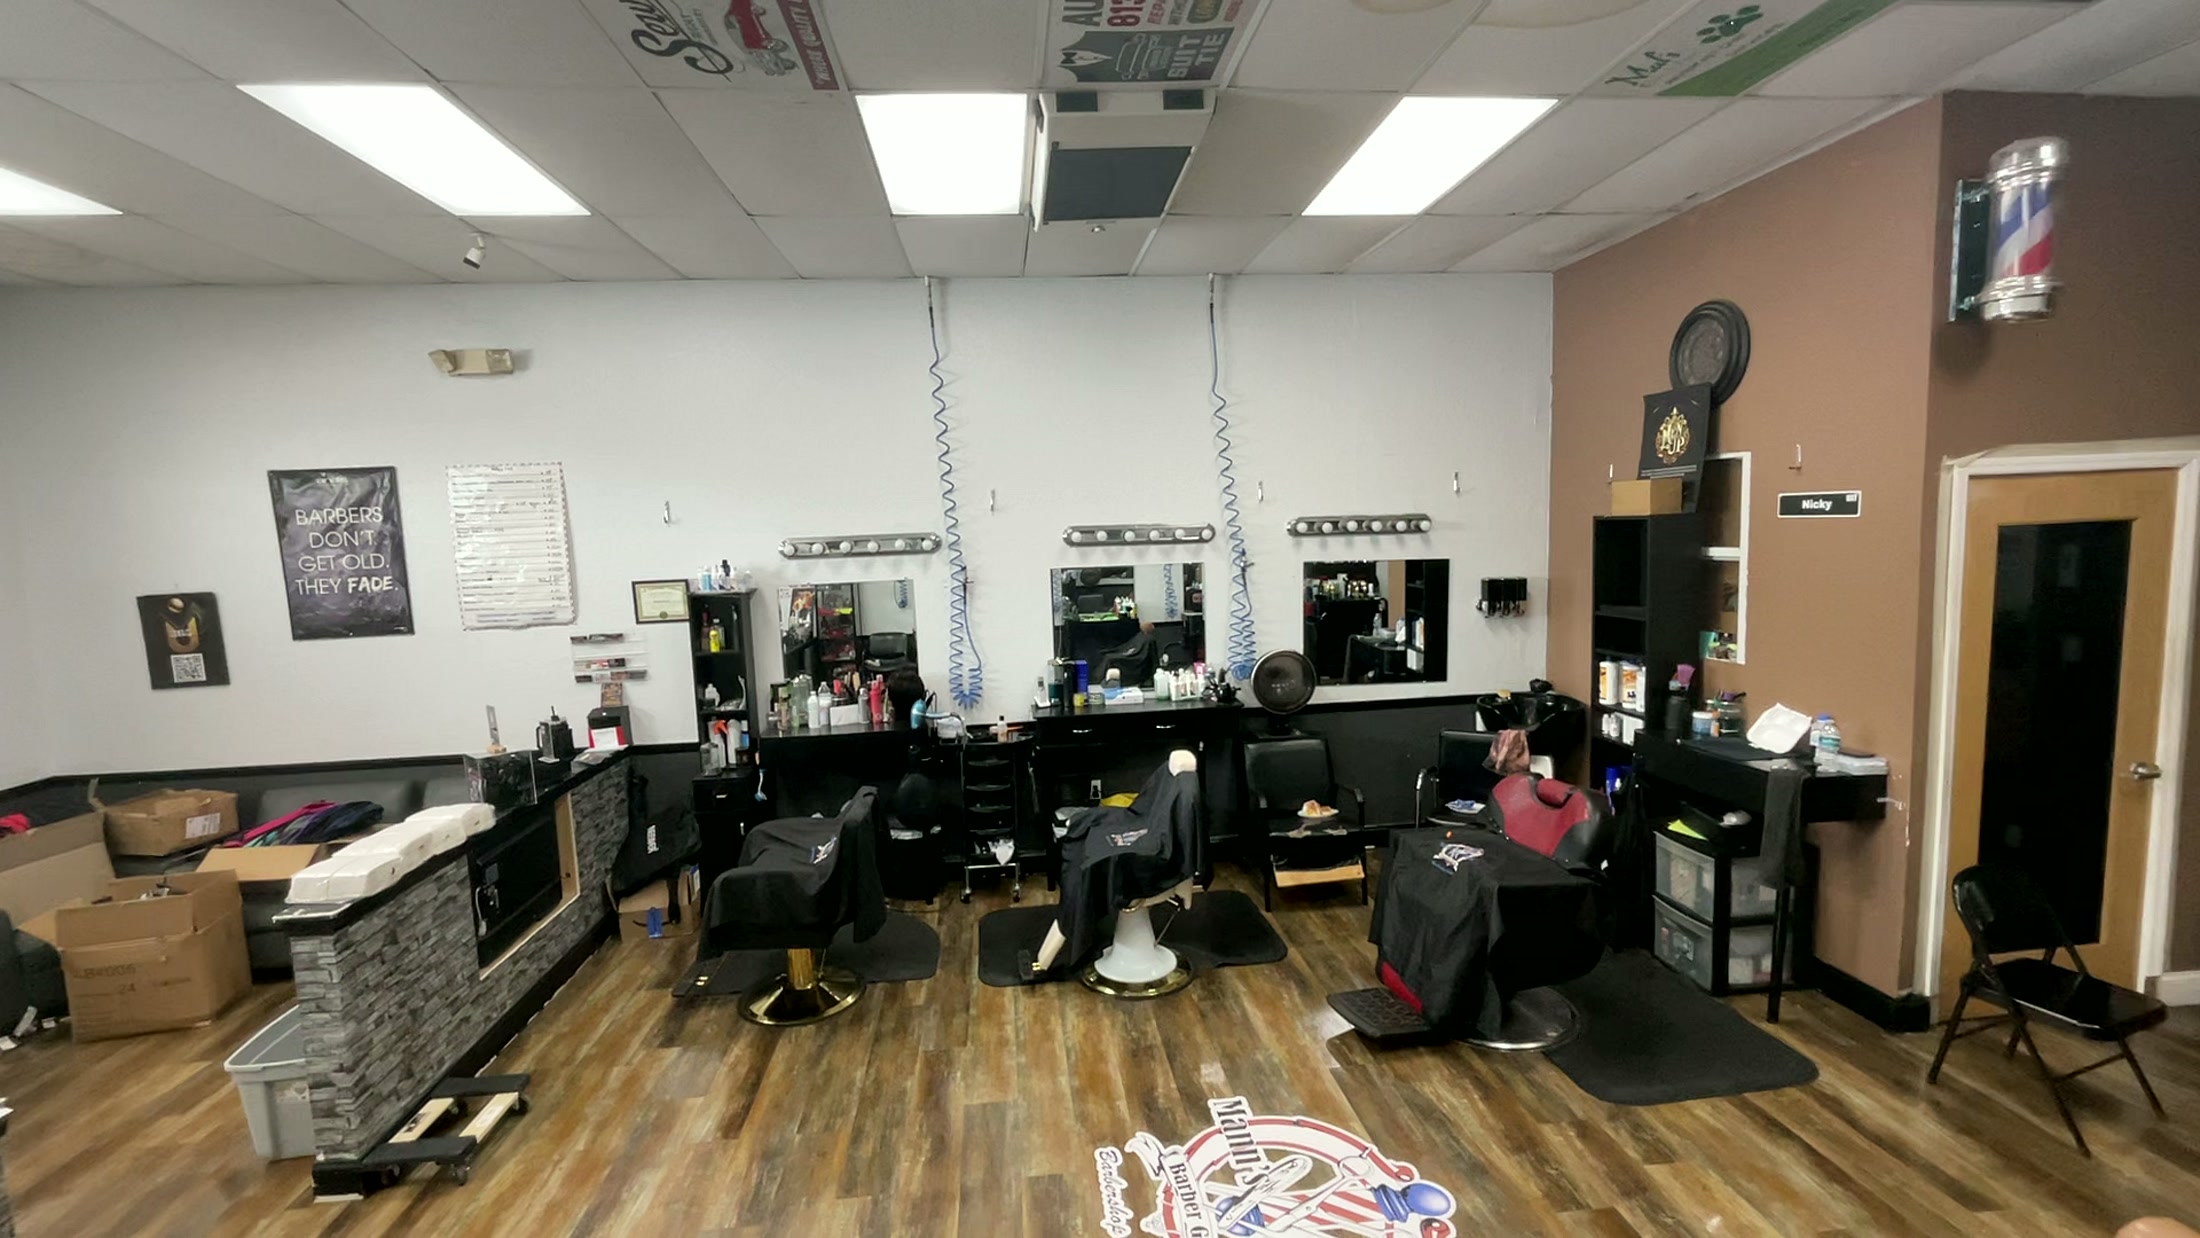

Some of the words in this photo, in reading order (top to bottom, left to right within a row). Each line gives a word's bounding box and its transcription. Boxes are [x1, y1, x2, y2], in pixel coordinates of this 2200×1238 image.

[1167, 35, 1201, 78] SUIT
[1195, 32, 1226, 67] TIE
[1801, 498, 1833, 511] Nicky
[295, 506, 384, 526] BARBERS
[308, 529, 375, 549] DON'T
[298, 554, 336, 572] GET
[342, 553, 390, 570] OLD.
[295, 577, 342, 595] THEY
[346, 576, 399, 594] FADE.
[1099, 1150, 1129, 1236] Barbershop
[1169, 1162, 1203, 1220] Barber
